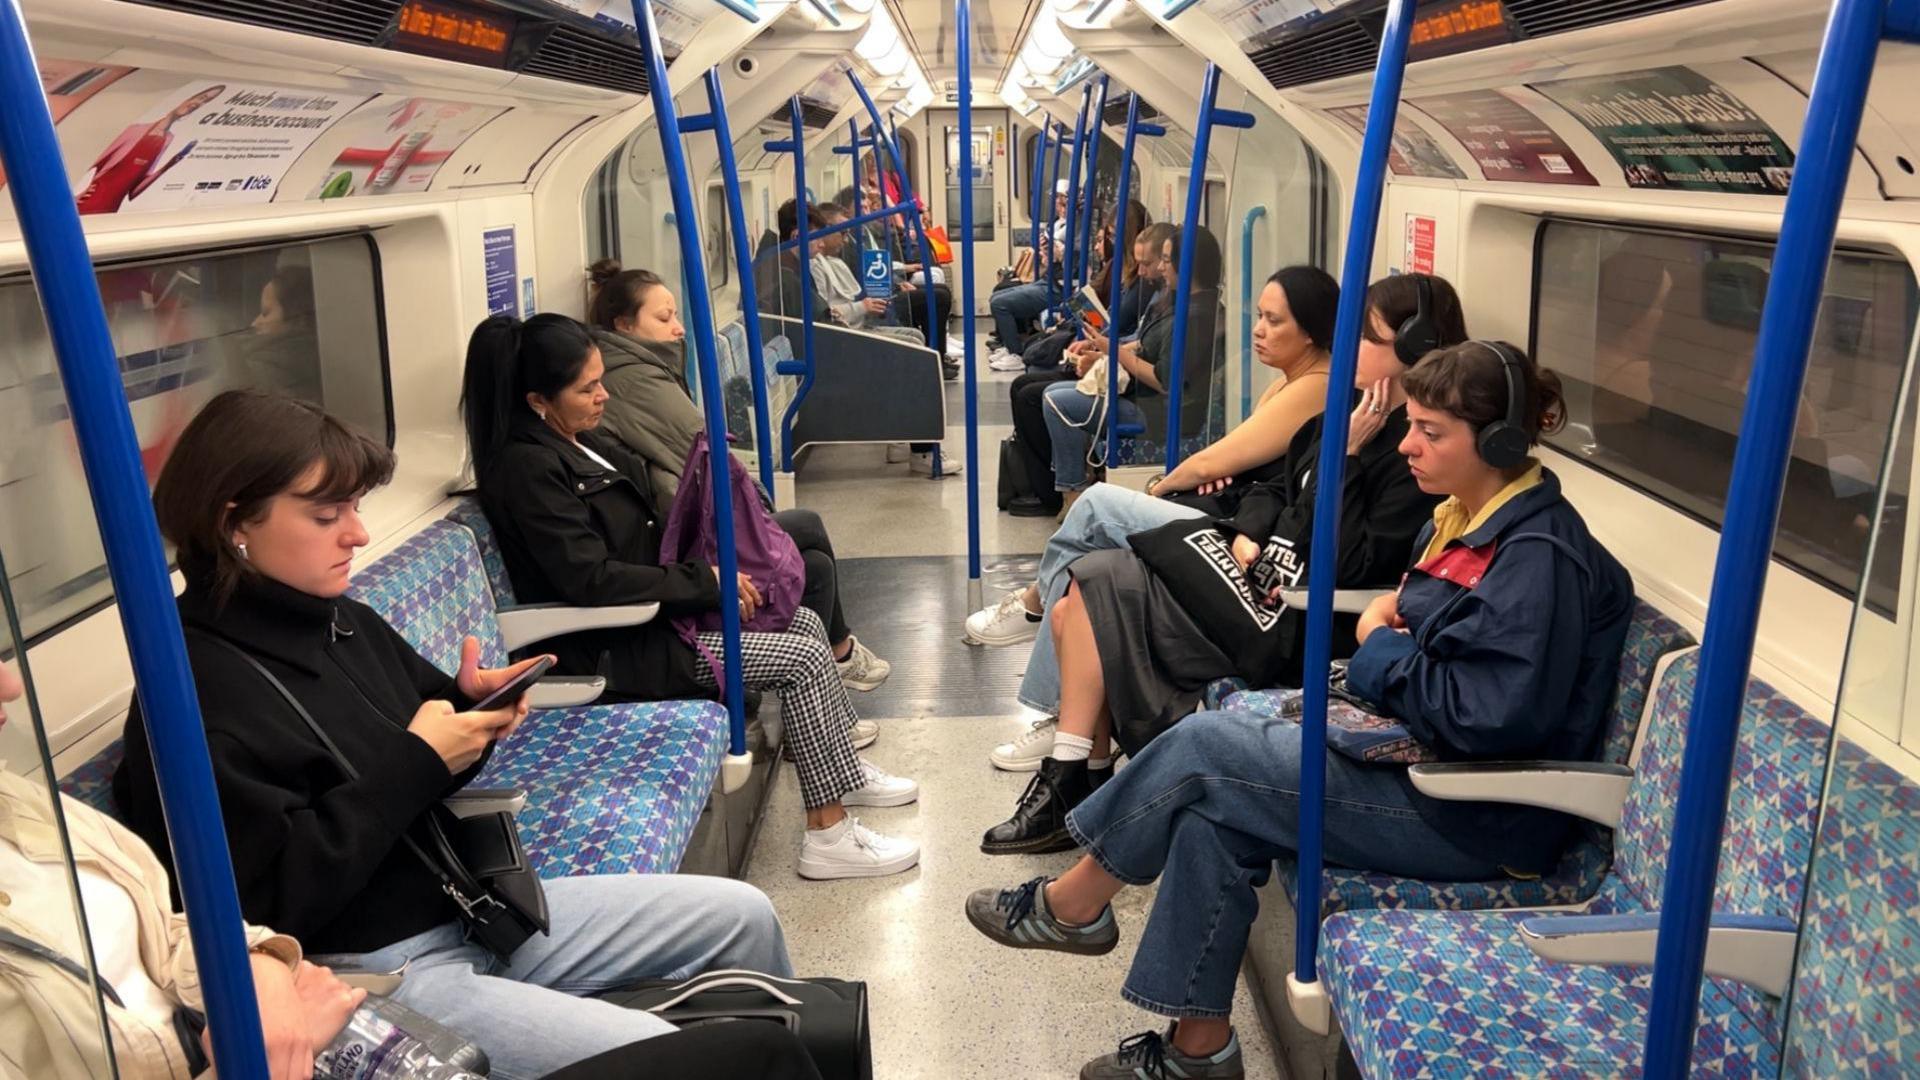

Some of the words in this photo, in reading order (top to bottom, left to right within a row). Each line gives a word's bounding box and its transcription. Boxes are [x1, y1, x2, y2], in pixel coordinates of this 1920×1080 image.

[1460, 1, 1505, 32] Brixton
[457, 19, 473, 45] to
[470, 20, 507, 53] Brixton
[224, 89, 277, 108] Much
[267, 95, 310, 109] more
[302, 95, 339, 111] than
[1576, 97, 1624, 128] Who
[1613, 91, 1682, 124] this
[1651, 84, 1759, 123] Jesus?
[198, 112, 218, 125] a
[211, 107, 279, 127] business
[272, 115, 333, 129] account
[249, 174, 272, 190] tide
[1262, 542, 1298, 571] NTEL
